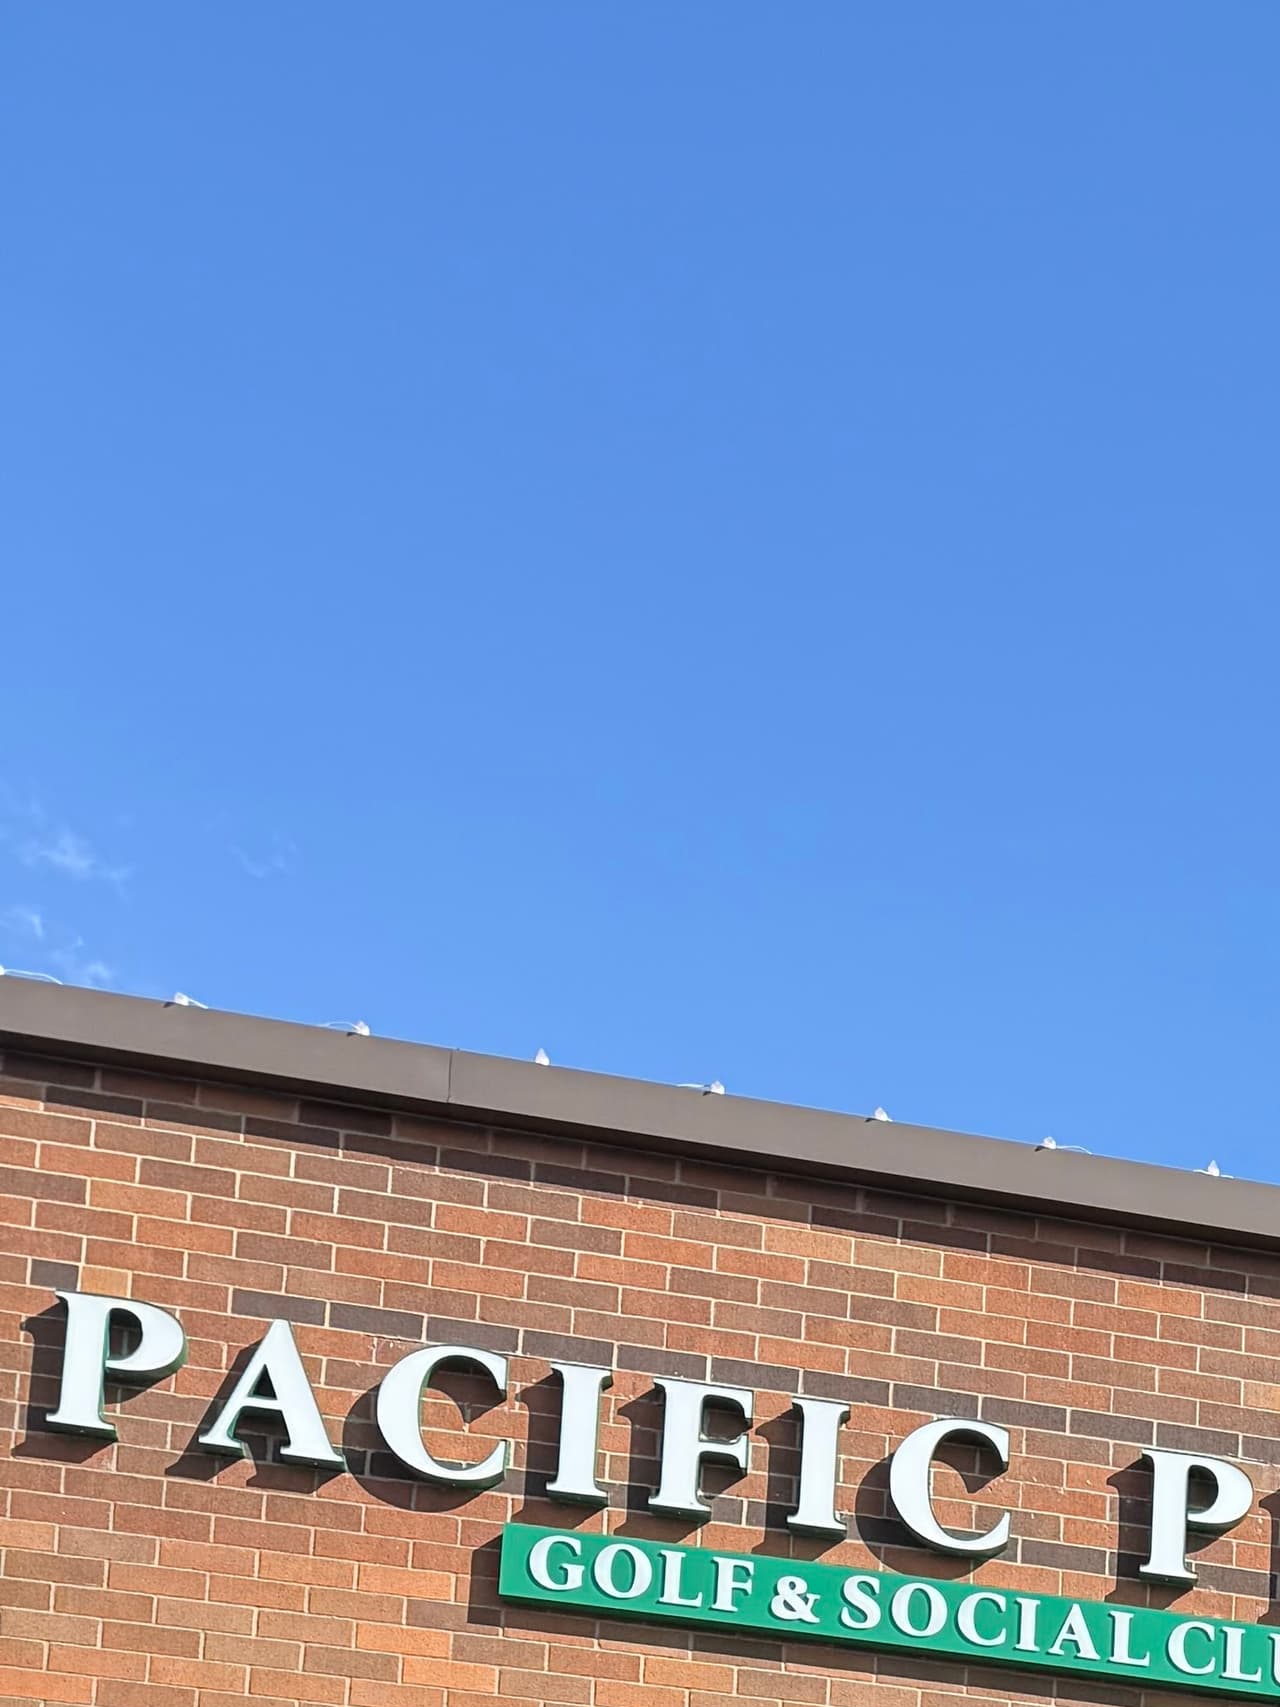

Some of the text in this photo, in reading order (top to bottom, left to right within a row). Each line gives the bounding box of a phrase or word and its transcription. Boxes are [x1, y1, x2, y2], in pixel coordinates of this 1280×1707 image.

[45, 1289, 1010, 1554] PACIFIC
[528, 1535, 755, 1612] GOLF
[770, 1575, 821, 1624] &
[840, 1575, 1150, 1666] SOCIAL
